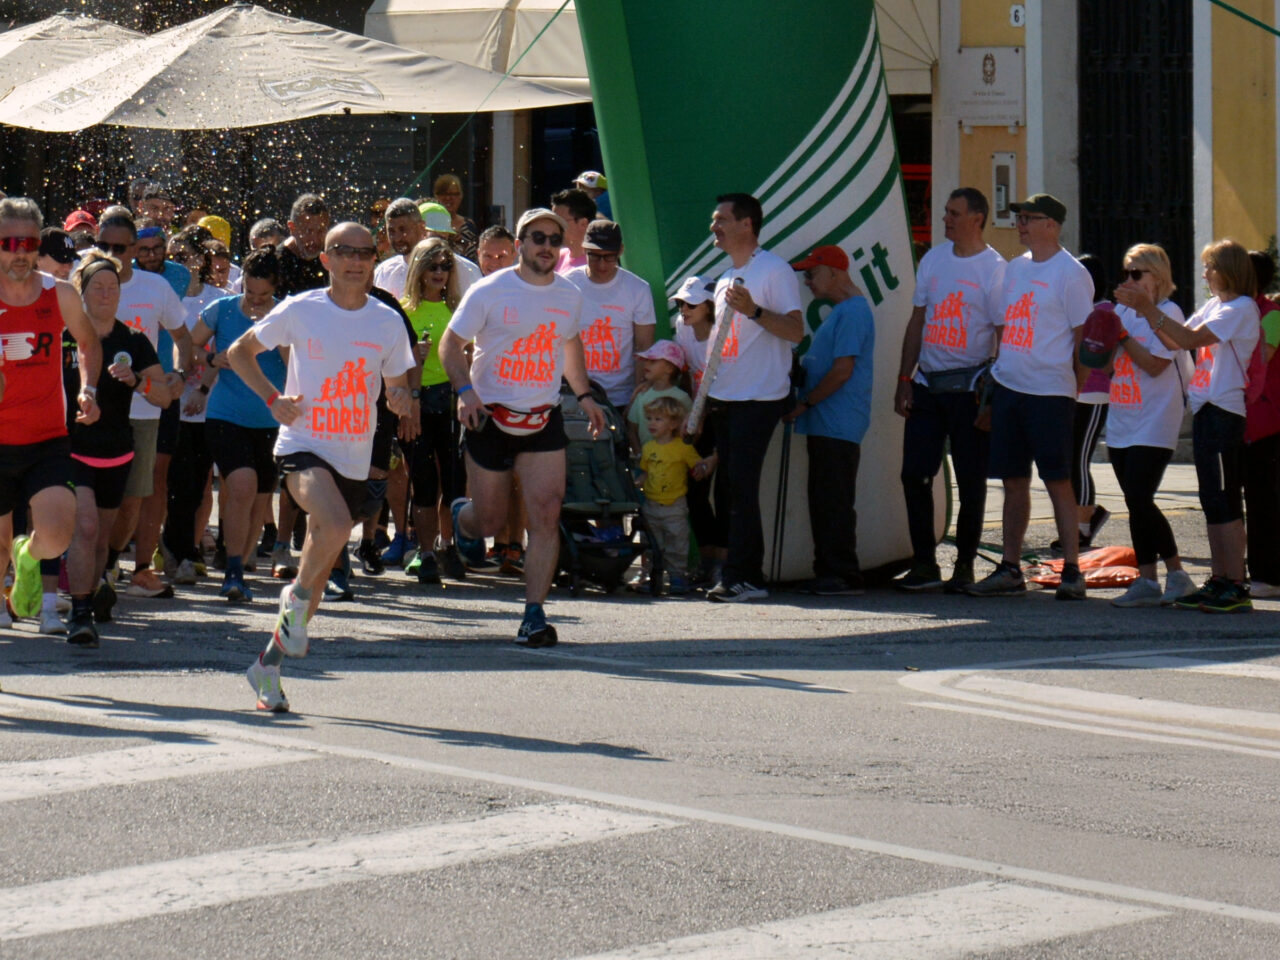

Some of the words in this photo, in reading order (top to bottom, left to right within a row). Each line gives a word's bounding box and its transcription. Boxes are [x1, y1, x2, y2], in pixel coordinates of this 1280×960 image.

[1014, 8, 1020, 24] 6
[499, 356, 555, 383] CORSA
[312, 406, 370, 435] CORSA
